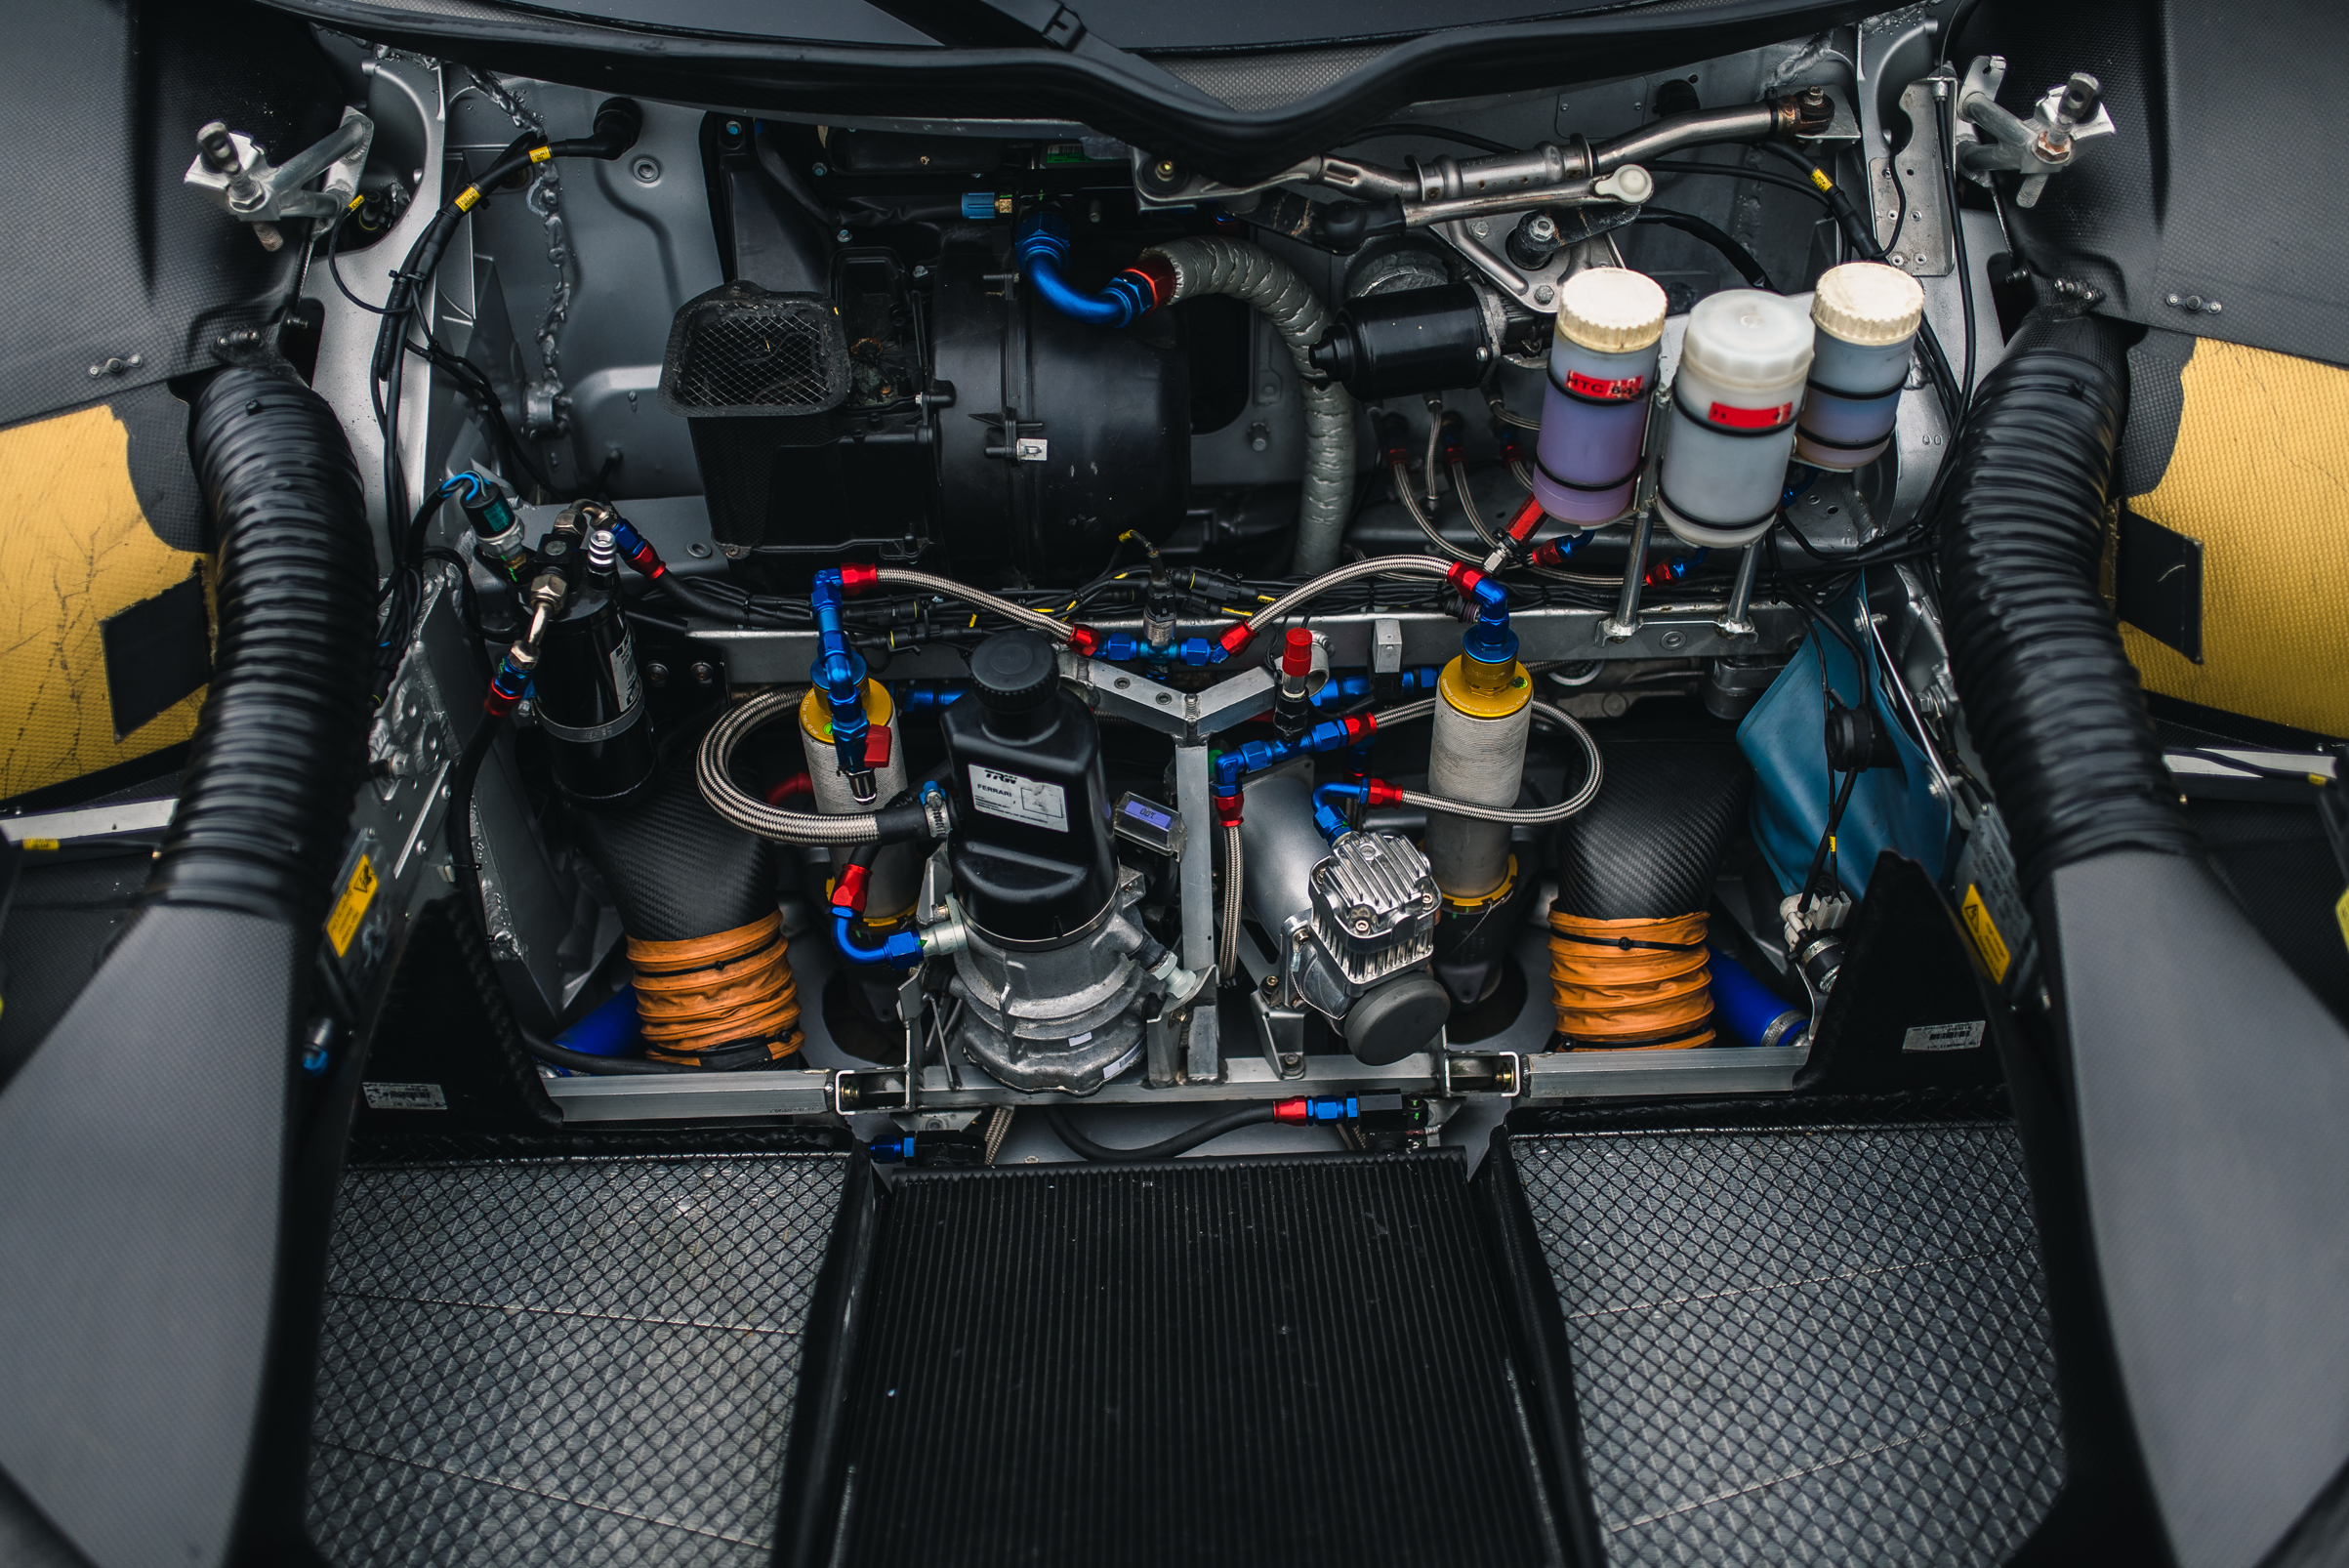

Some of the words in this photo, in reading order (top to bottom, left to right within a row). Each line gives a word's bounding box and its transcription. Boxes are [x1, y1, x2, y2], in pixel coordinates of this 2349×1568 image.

[1567, 374, 1603, 393] HTC
[984, 768, 1018, 785] TRW
[977, 783, 1012, 798] FERRARI
